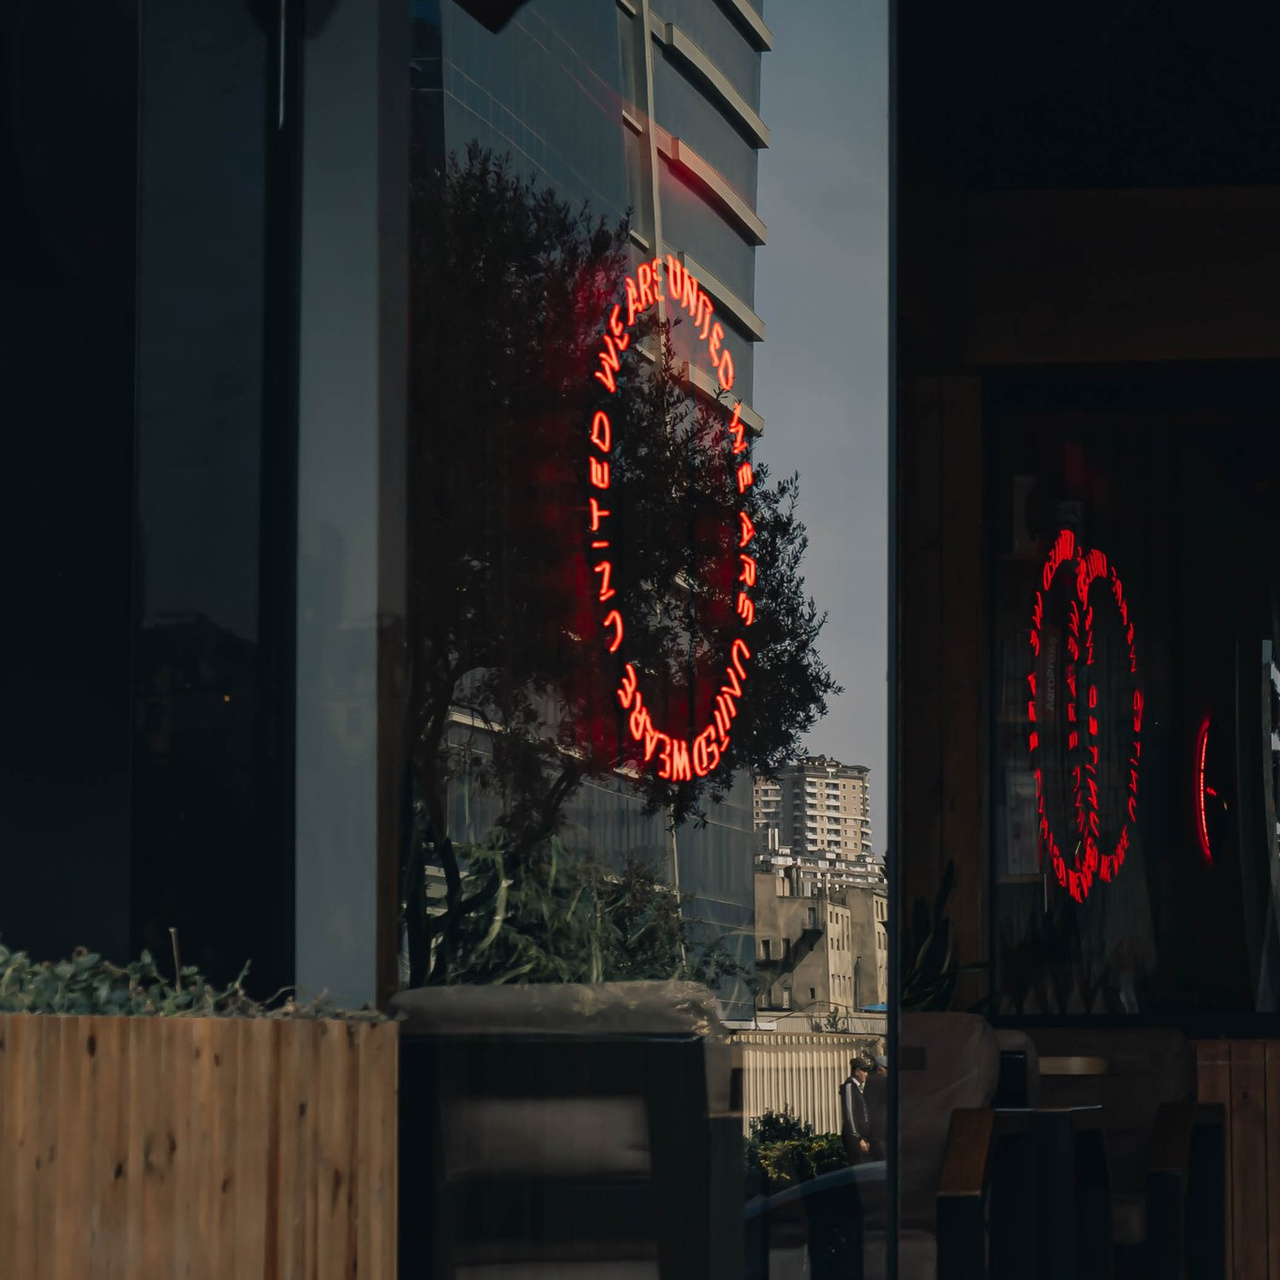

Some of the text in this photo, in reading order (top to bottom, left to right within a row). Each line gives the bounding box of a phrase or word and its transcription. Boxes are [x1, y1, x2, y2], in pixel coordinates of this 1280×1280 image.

[595, 303, 631, 393] WE
[624, 257, 666, 326] ARE
[666, 253, 736, 391] UNITED
[589, 410, 624, 653] UNITED
[736, 511, 756, 626] ARE
